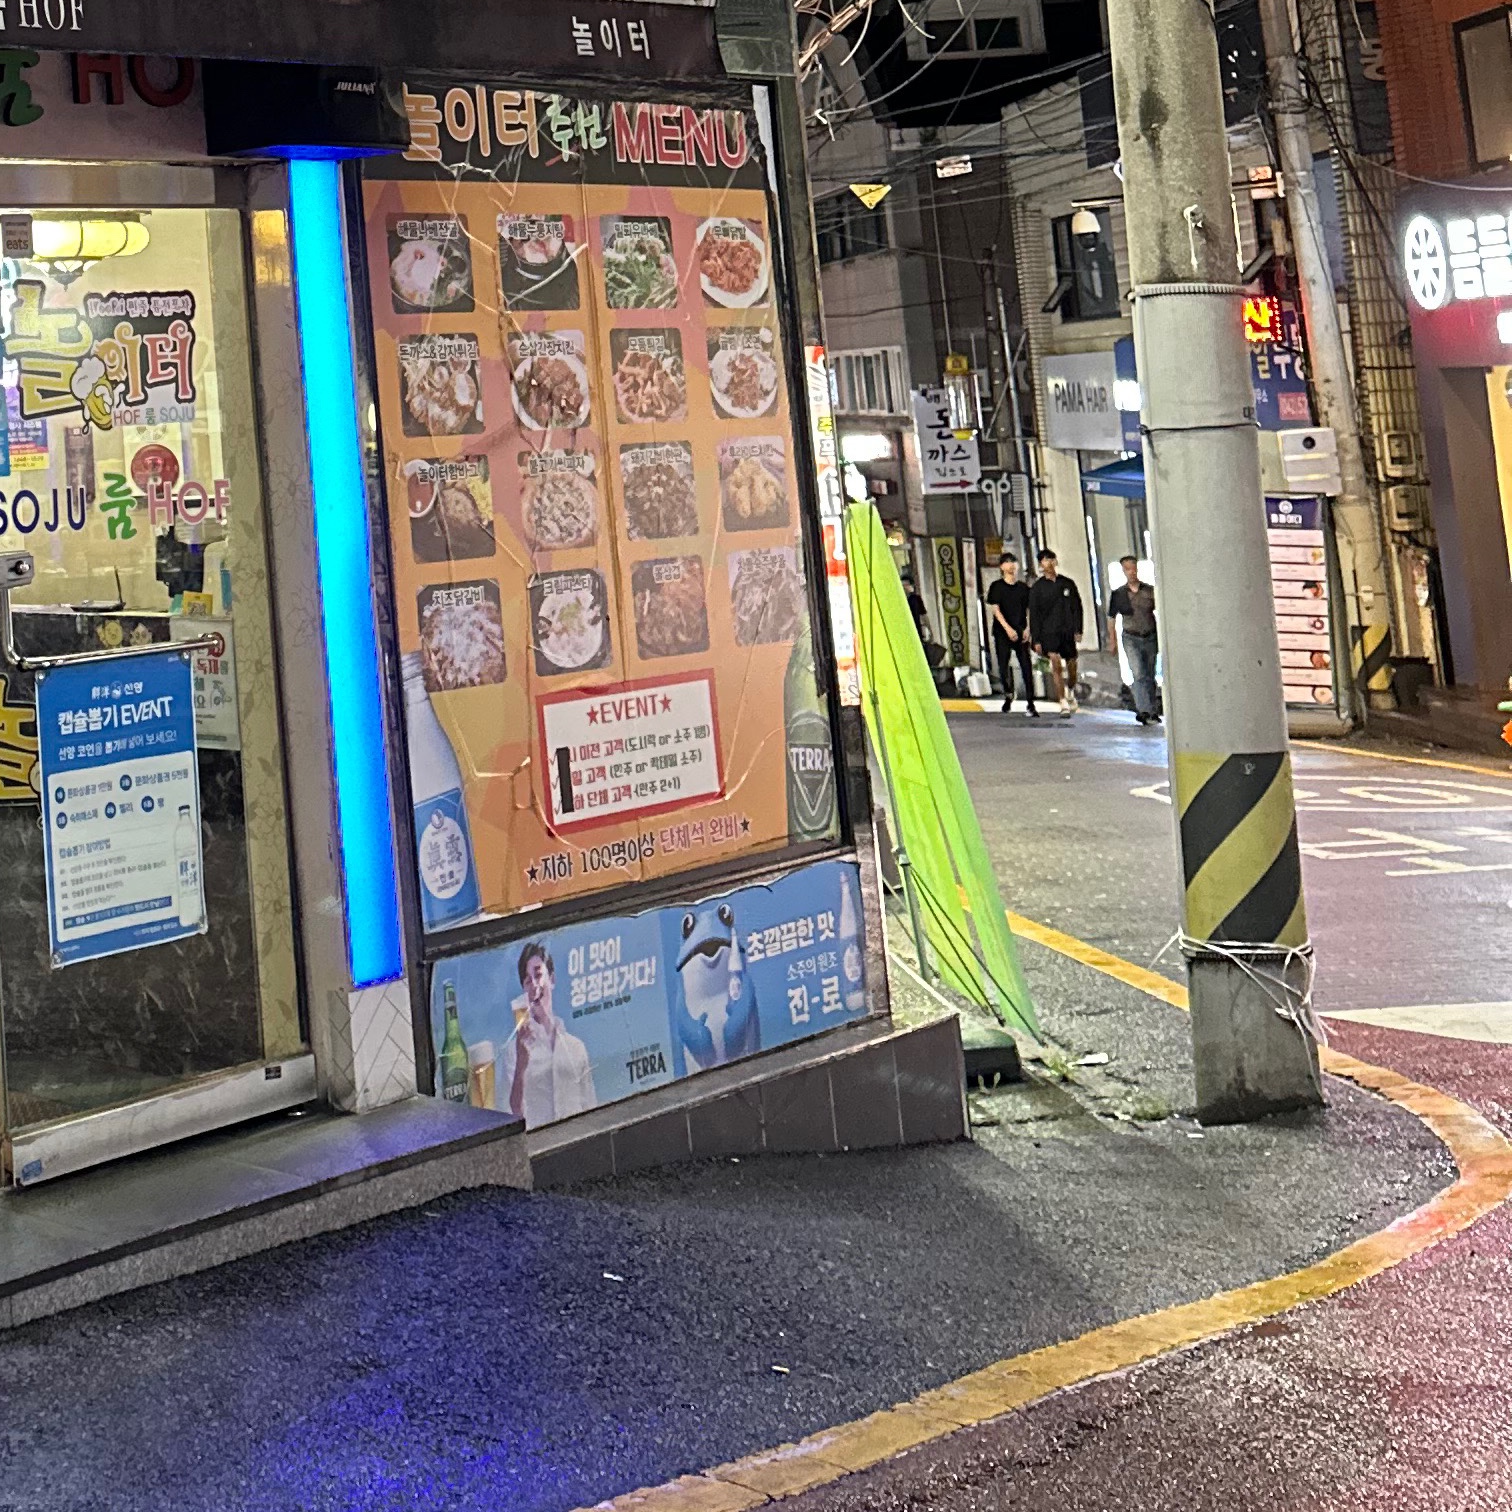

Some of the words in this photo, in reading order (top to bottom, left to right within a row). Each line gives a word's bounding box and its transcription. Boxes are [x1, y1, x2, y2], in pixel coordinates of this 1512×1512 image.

[572, 15, 651, 61] 놀이터
[72, 52, 198, 109] HO
[402, 82, 540, 163] 놀이터
[613, 100, 747, 169] MENU
[113, 409, 141, 426] HOF
[159, 406, 196, 423] SOJU
[147, 478, 231, 527] HOF
[120, 695, 174, 726] EVENT
[599, 694, 659, 725] EVENT
[790, 746, 834, 774] TERRA
[541, 851, 574, 882] 지하
[580, 831, 656, 874] 100명이상
[659, 822, 706, 854] 단체석
[709, 815, 740, 845] 완비
[568, 944, 585, 977] 이
[589, 935, 621, 972] 맛이
[747, 916, 815, 964] 초깔끔한
[816, 910, 835, 942] 맛
[786, 955, 818, 982] 소주의
[625, 1050, 667, 1085] TERRA
